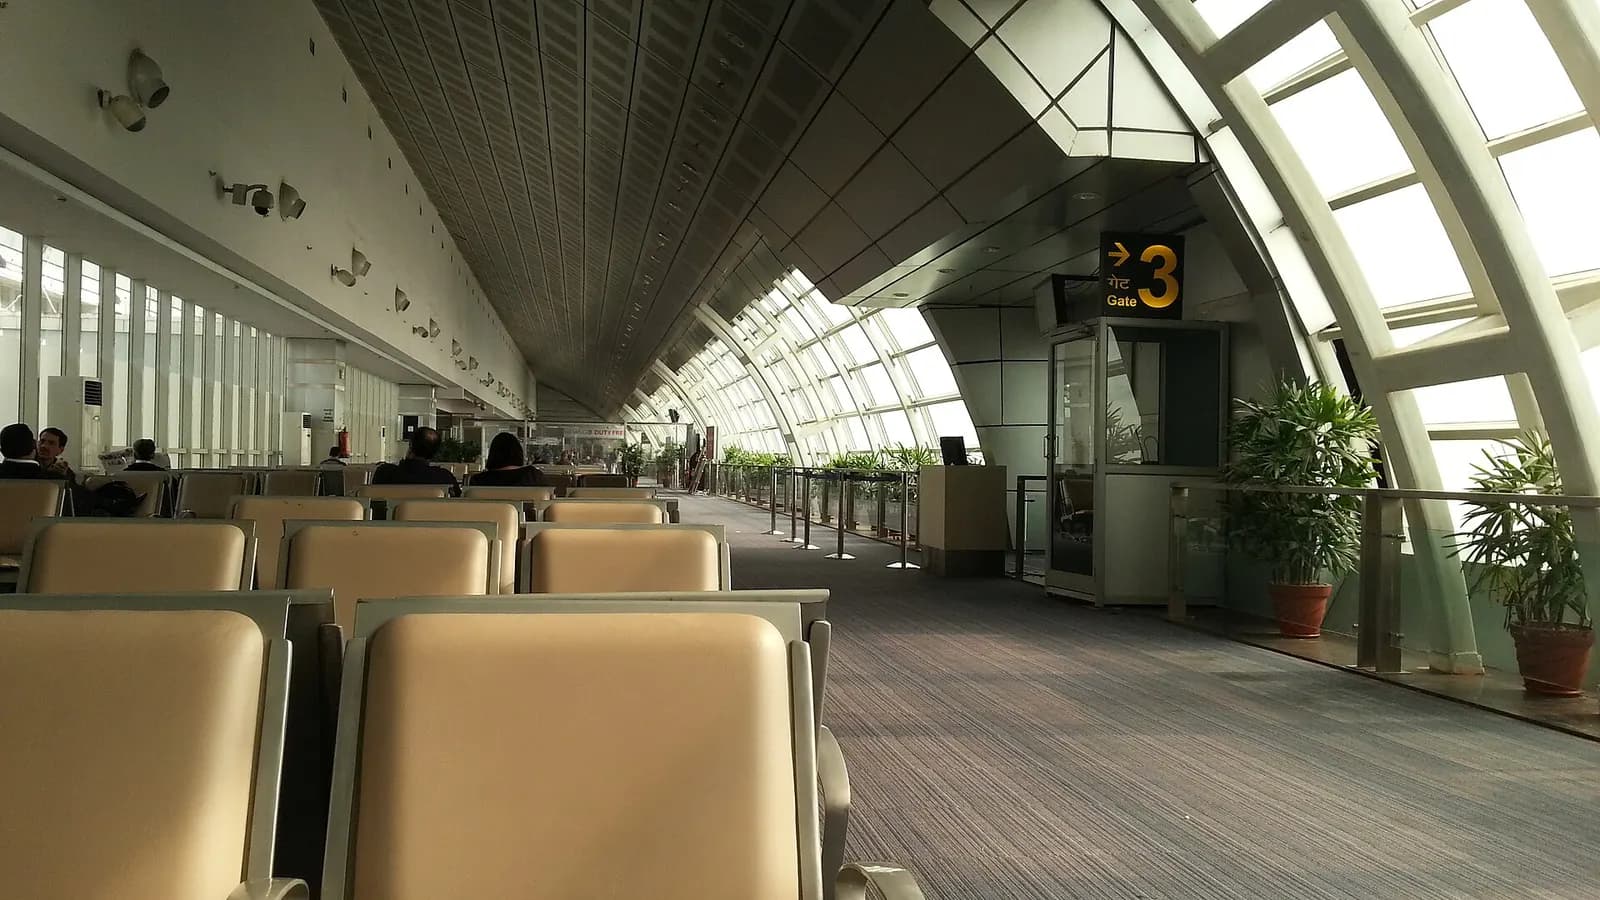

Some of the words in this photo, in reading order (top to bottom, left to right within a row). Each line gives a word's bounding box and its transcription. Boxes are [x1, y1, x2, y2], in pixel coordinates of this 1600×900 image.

[1107, 273, 1130, 289] गेट
[1138, 244, 1179, 308] 3
[1107, 294, 1137, 307] Gate
